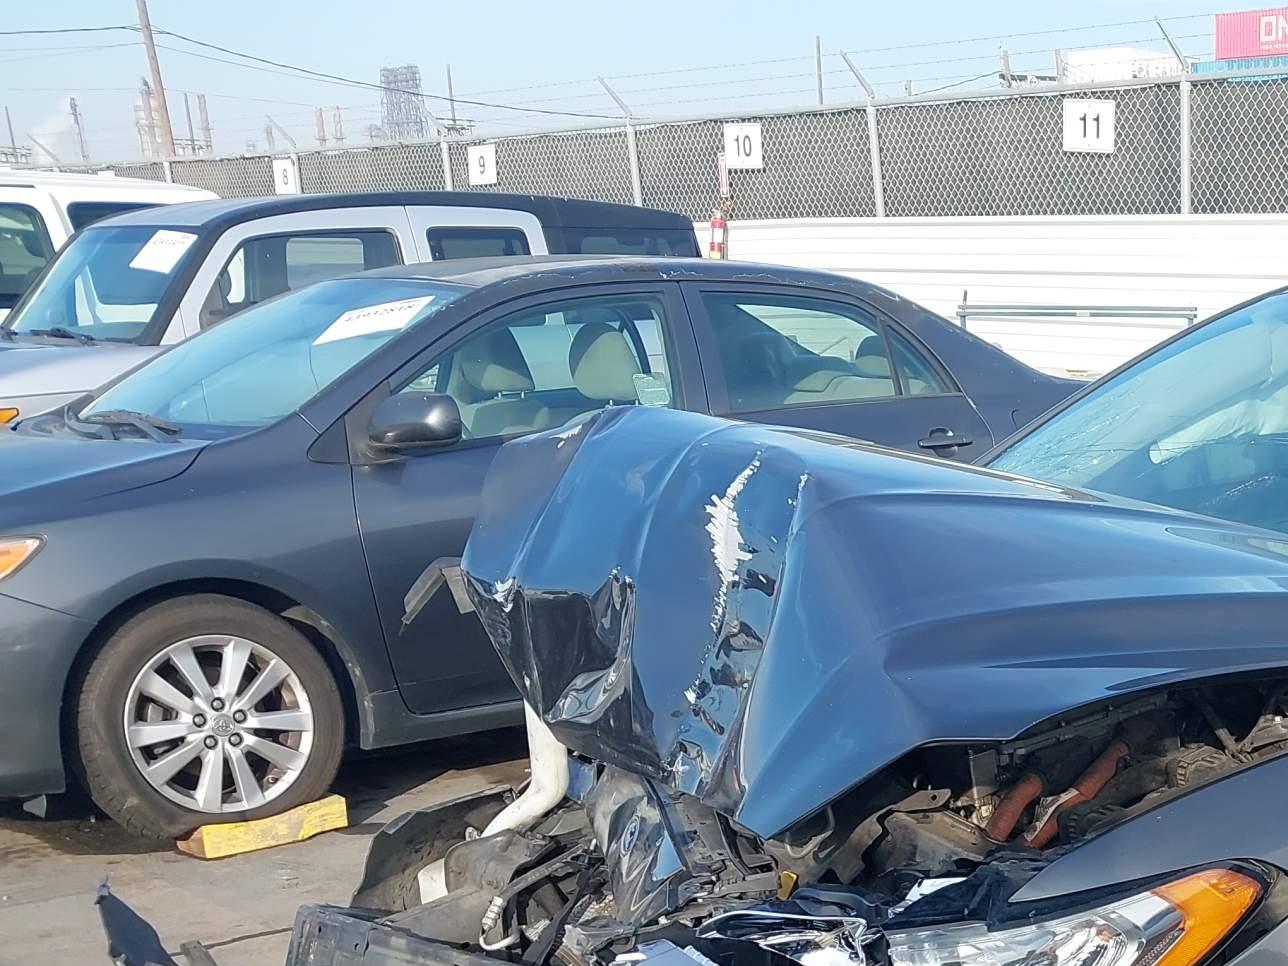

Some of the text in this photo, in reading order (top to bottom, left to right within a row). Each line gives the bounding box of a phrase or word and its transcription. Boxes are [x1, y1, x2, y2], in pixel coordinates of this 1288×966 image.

[1079, 112, 1100, 139] 11
[733, 135, 752, 157] 10
[479, 155, 486, 175] 9
[282, 168, 289, 186] 8
